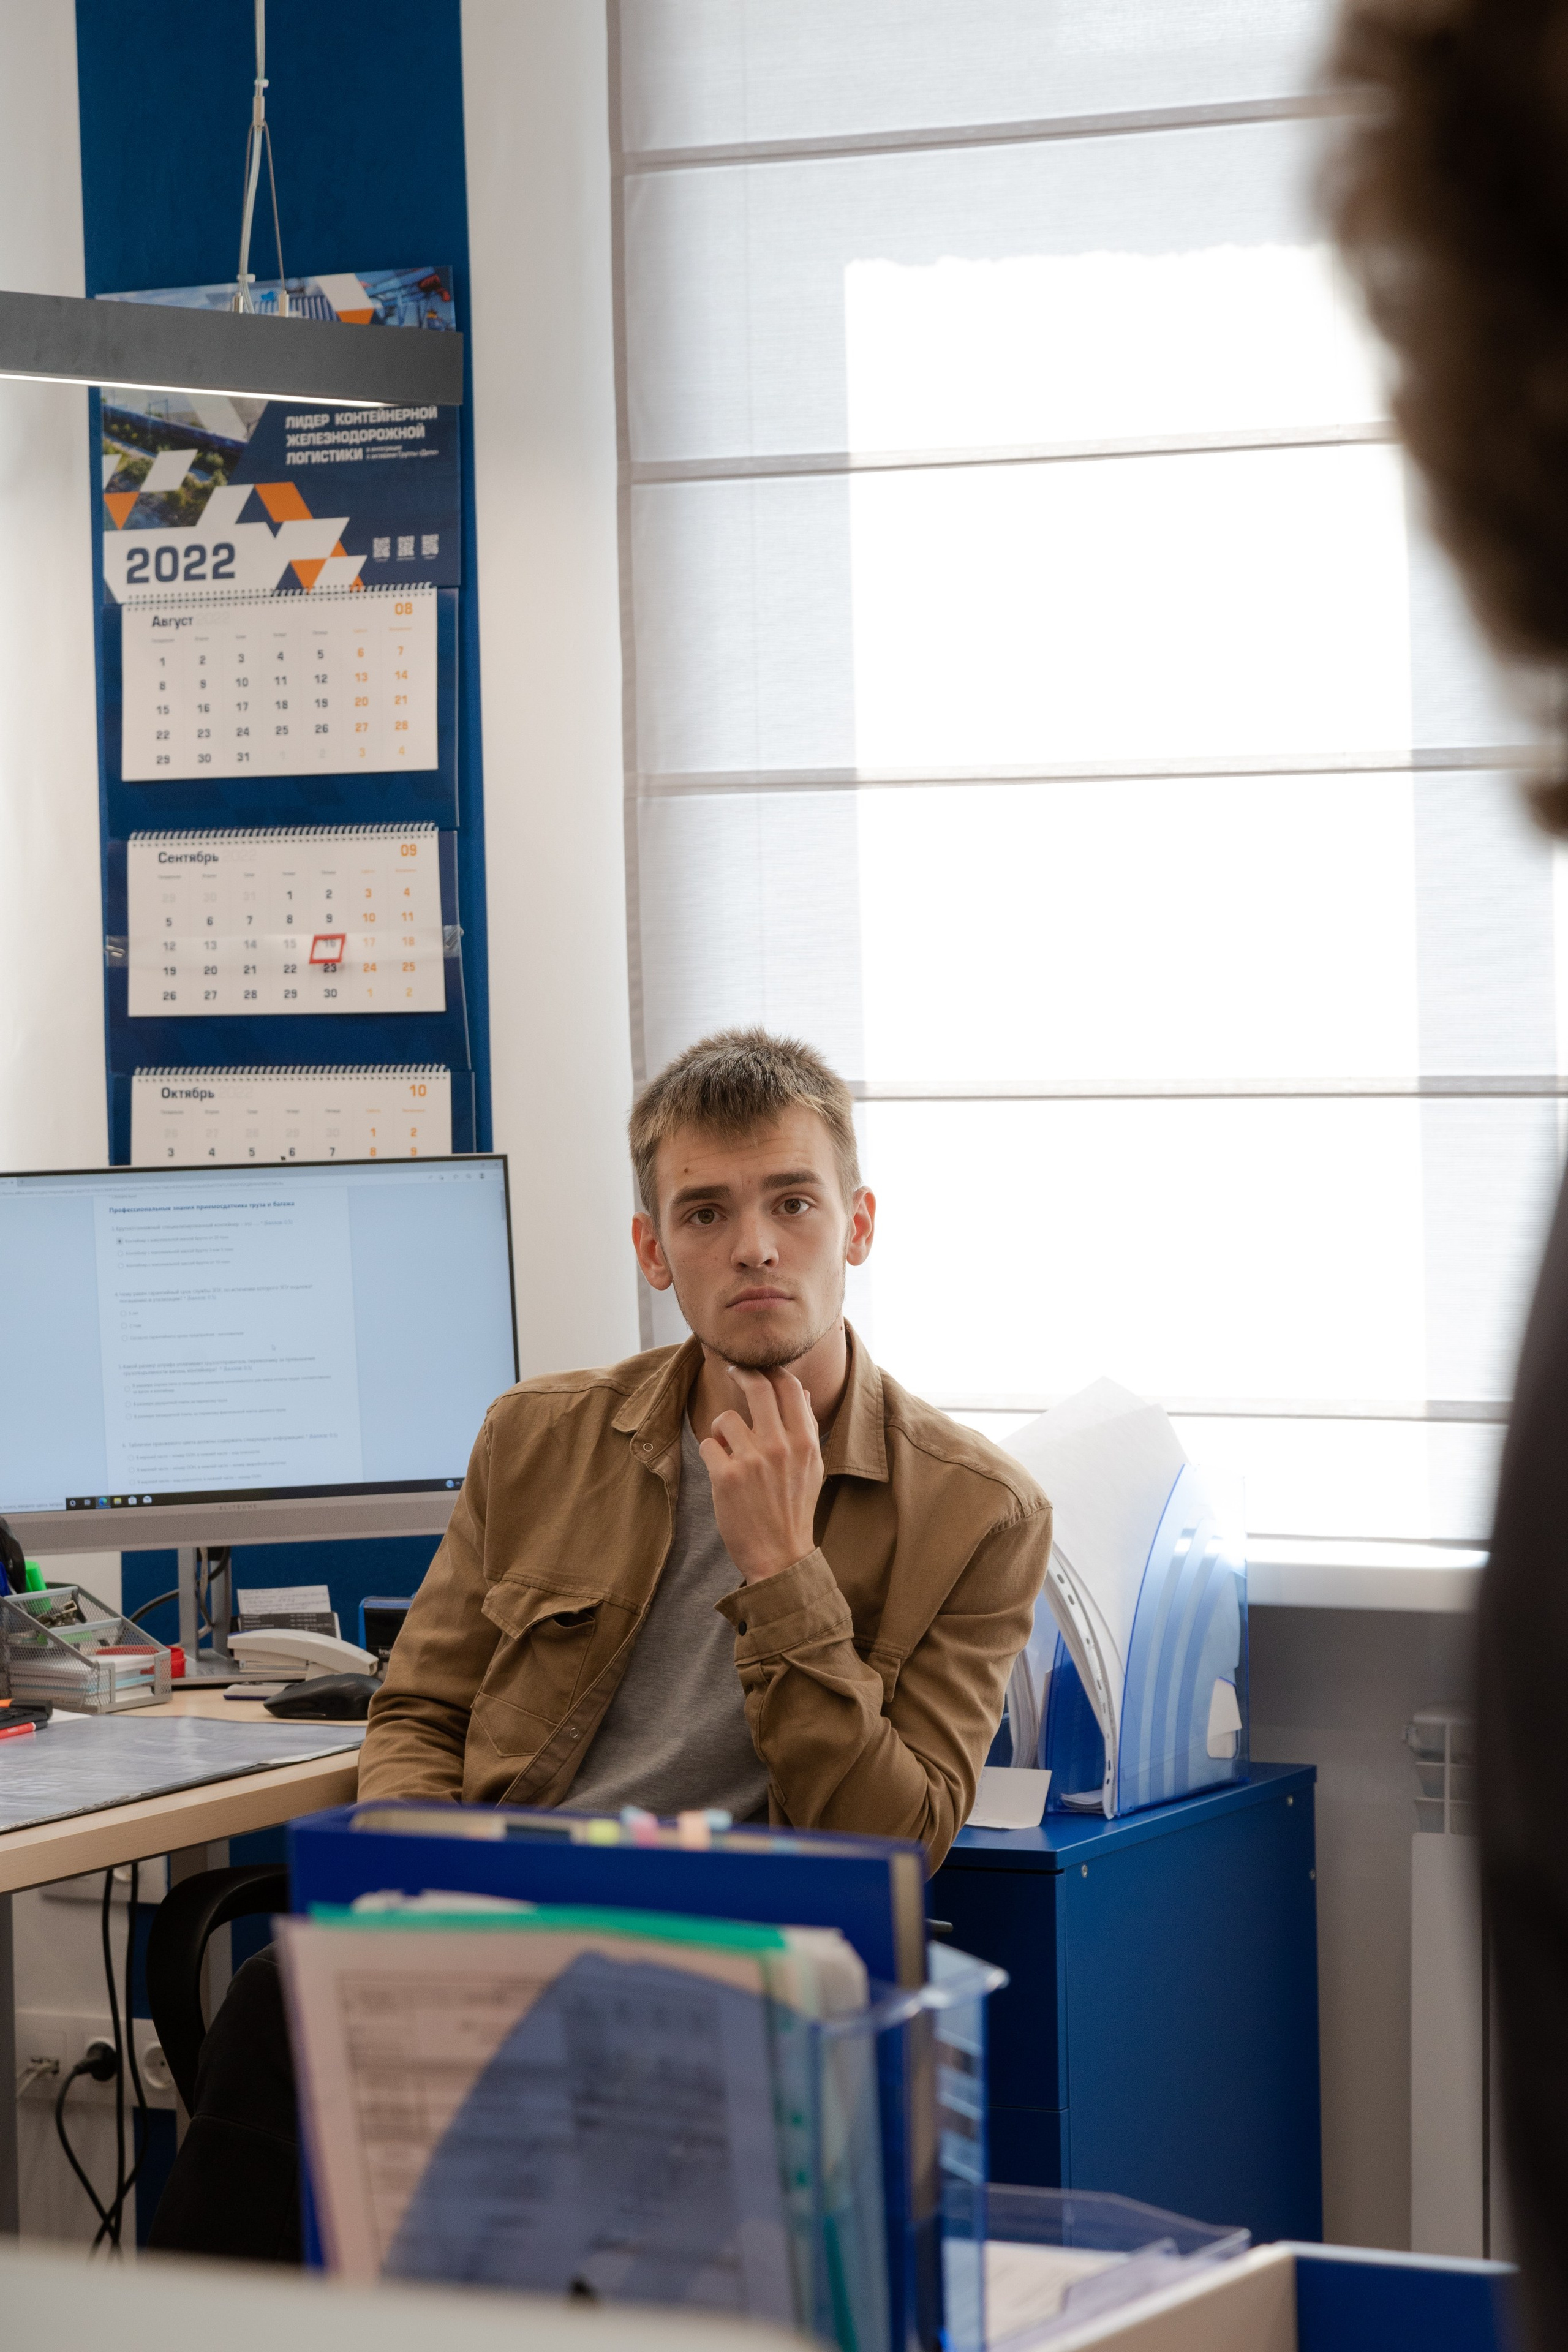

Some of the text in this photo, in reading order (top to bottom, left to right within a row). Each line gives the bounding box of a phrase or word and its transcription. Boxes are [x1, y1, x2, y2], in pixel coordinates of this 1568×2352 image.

[285, 405, 437, 429] ЛИДЕР КОНТЕЙНЕРНОЙ
[286, 423, 425, 447] ЖЕЛЕЗНОДОРОЖНОЙ
[286, 448, 363, 466] ЛОГИСТИКИ
[127, 542, 235, 584] 2022
[395, 602, 413, 615] 08
[152, 615, 194, 629] Август
[159, 645, 404, 667] 1 2 3 4 5 6 7
[159, 670, 409, 692] 8 9 10 11 12 13 14
[156, 695, 408, 715] 15 16 17 18 19 20 21
[156, 720, 409, 741] 22 23 24 25 26 27 28
[156, 755, 171, 765] 29
[198, 753, 212, 764] 30
[237, 752, 250, 763] 31
[358, 747, 366, 758] 3
[398, 746, 405, 756] 4
[158, 851, 219, 865] Сентябрь
[401, 844, 418, 857] 09
[286, 890, 293, 900] 1
[325, 889, 333, 900] 2
[365, 888, 372, 899] 3
[403, 887, 411, 897] 4
[165, 911, 414, 928] 5 6 7 8 9 10 11
[162, 941, 176, 952] 12
[203, 940, 218, 951] 13
[244, 940, 257, 949] 14
[283, 938, 298, 949] 15
[363, 937, 376, 947] 17
[402, 936, 415, 947] 18
[163, 961, 416, 976] 19 20 21 22 23 24 25
[162, 987, 413, 1001] 26 27 28 29 30 1 2
[161, 1087, 215, 1101] Октябрь
[410, 1084, 427, 1097] 10
[370, 1127, 377, 1137] 1
[410, 1127, 418, 1138] 2
[167, 1147, 175, 1158] 3
[208, 1147, 216, 1157] 4
[248, 1147, 256, 1158] 5
[288, 1147, 296, 1157] 6
[329, 1147, 336, 1157] 7
[196, 1202, 247, 1211] приемосдатчика
